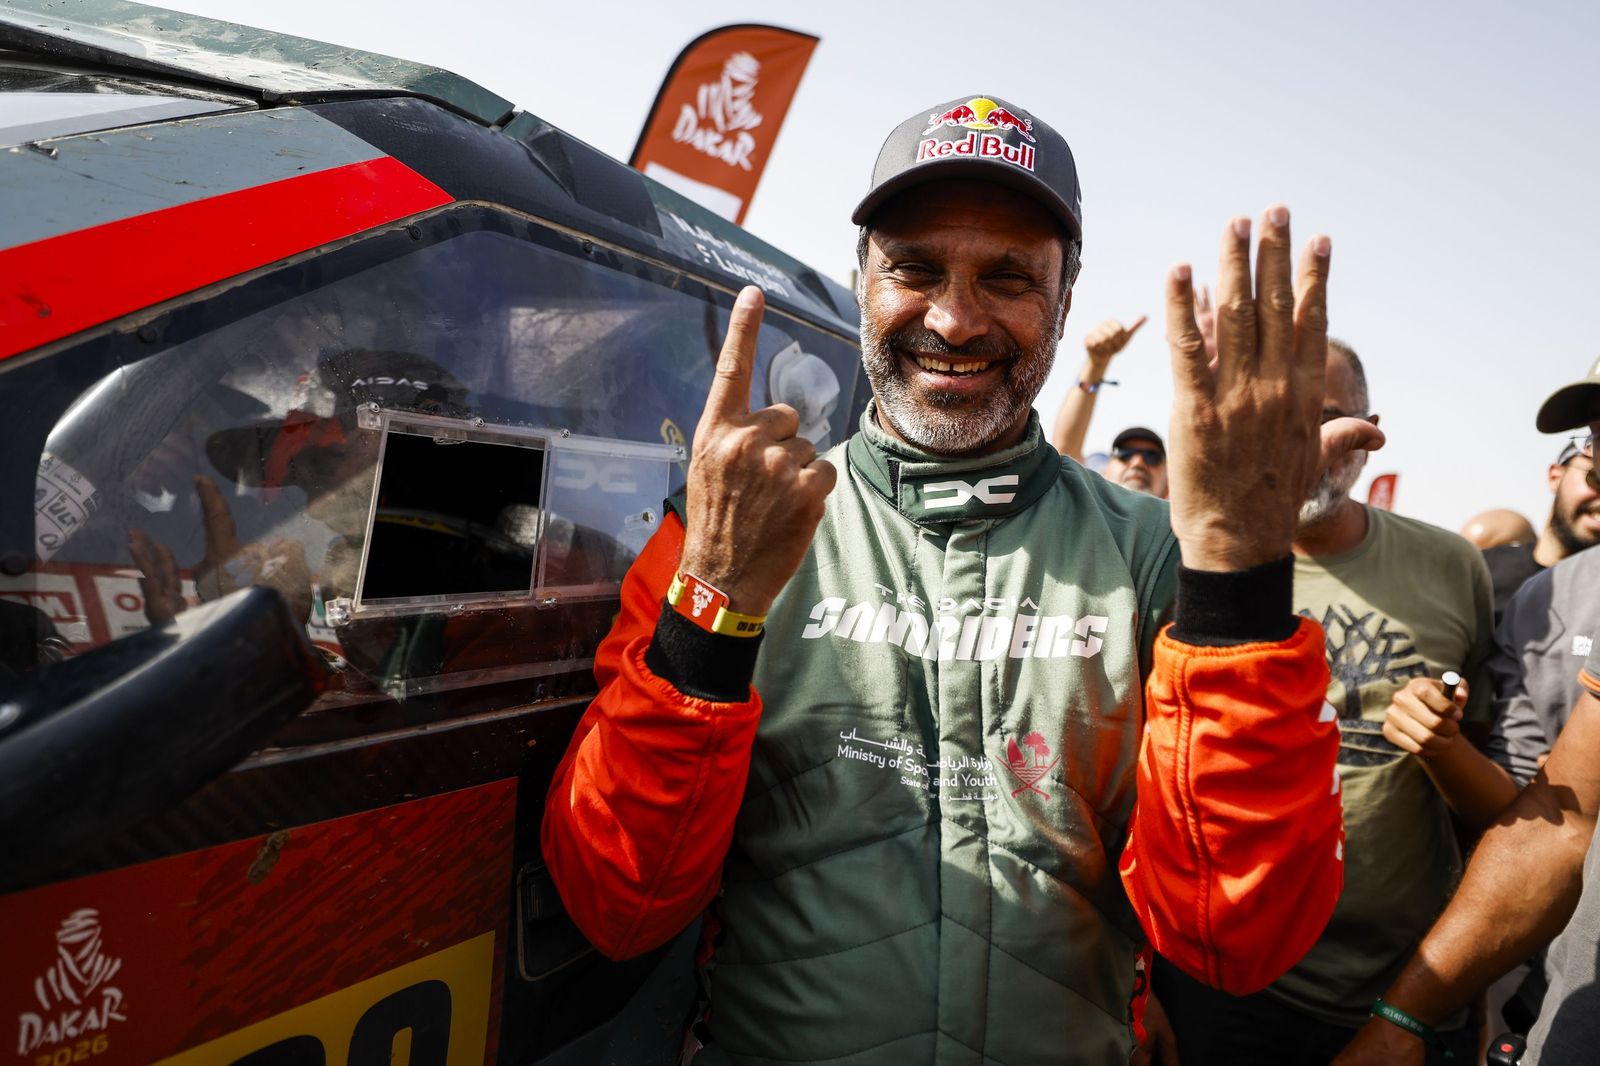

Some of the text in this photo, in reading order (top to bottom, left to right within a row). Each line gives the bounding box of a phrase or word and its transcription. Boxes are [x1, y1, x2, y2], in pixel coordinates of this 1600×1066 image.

[673, 104, 756, 171] DAKAR
[916, 131, 1036, 172] Red Bull
[938, 596, 1041, 612] DACIA
[801, 597, 1109, 661] SANDRIDERS
[837, 744, 886, 769] Ministry
[889, 756, 903, 769] of
[933, 774, 958, 787] and
[961, 773, 998, 787] Youth
[900, 776, 922, 788] State
[18, 986, 127, 1056] DAKAR
